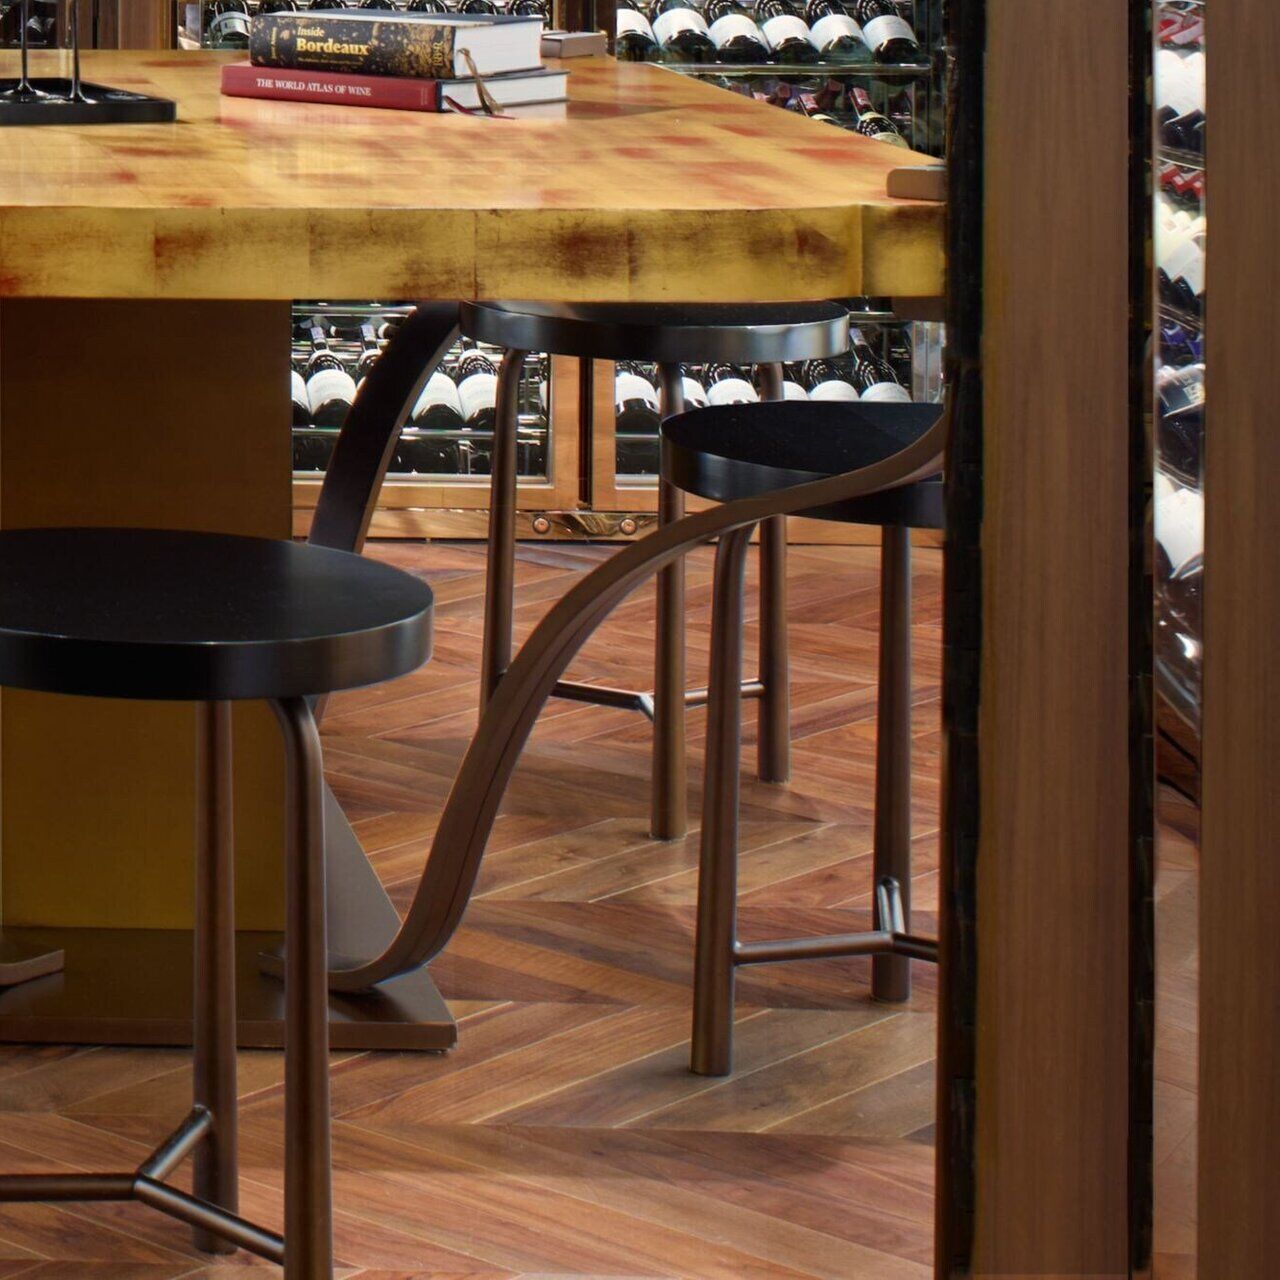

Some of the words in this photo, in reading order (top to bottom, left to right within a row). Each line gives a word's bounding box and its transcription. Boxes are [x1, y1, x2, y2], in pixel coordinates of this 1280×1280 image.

[297, 26, 325, 37] Inside
[296, 38, 370, 56] Bordeaux
[256, 77, 274, 88] THE
[275, 79, 305, 91] WORLD
[306, 81, 334, 93] ATLAS
[334, 85, 346, 94] OF
[347, 86, 372, 97] WINE
